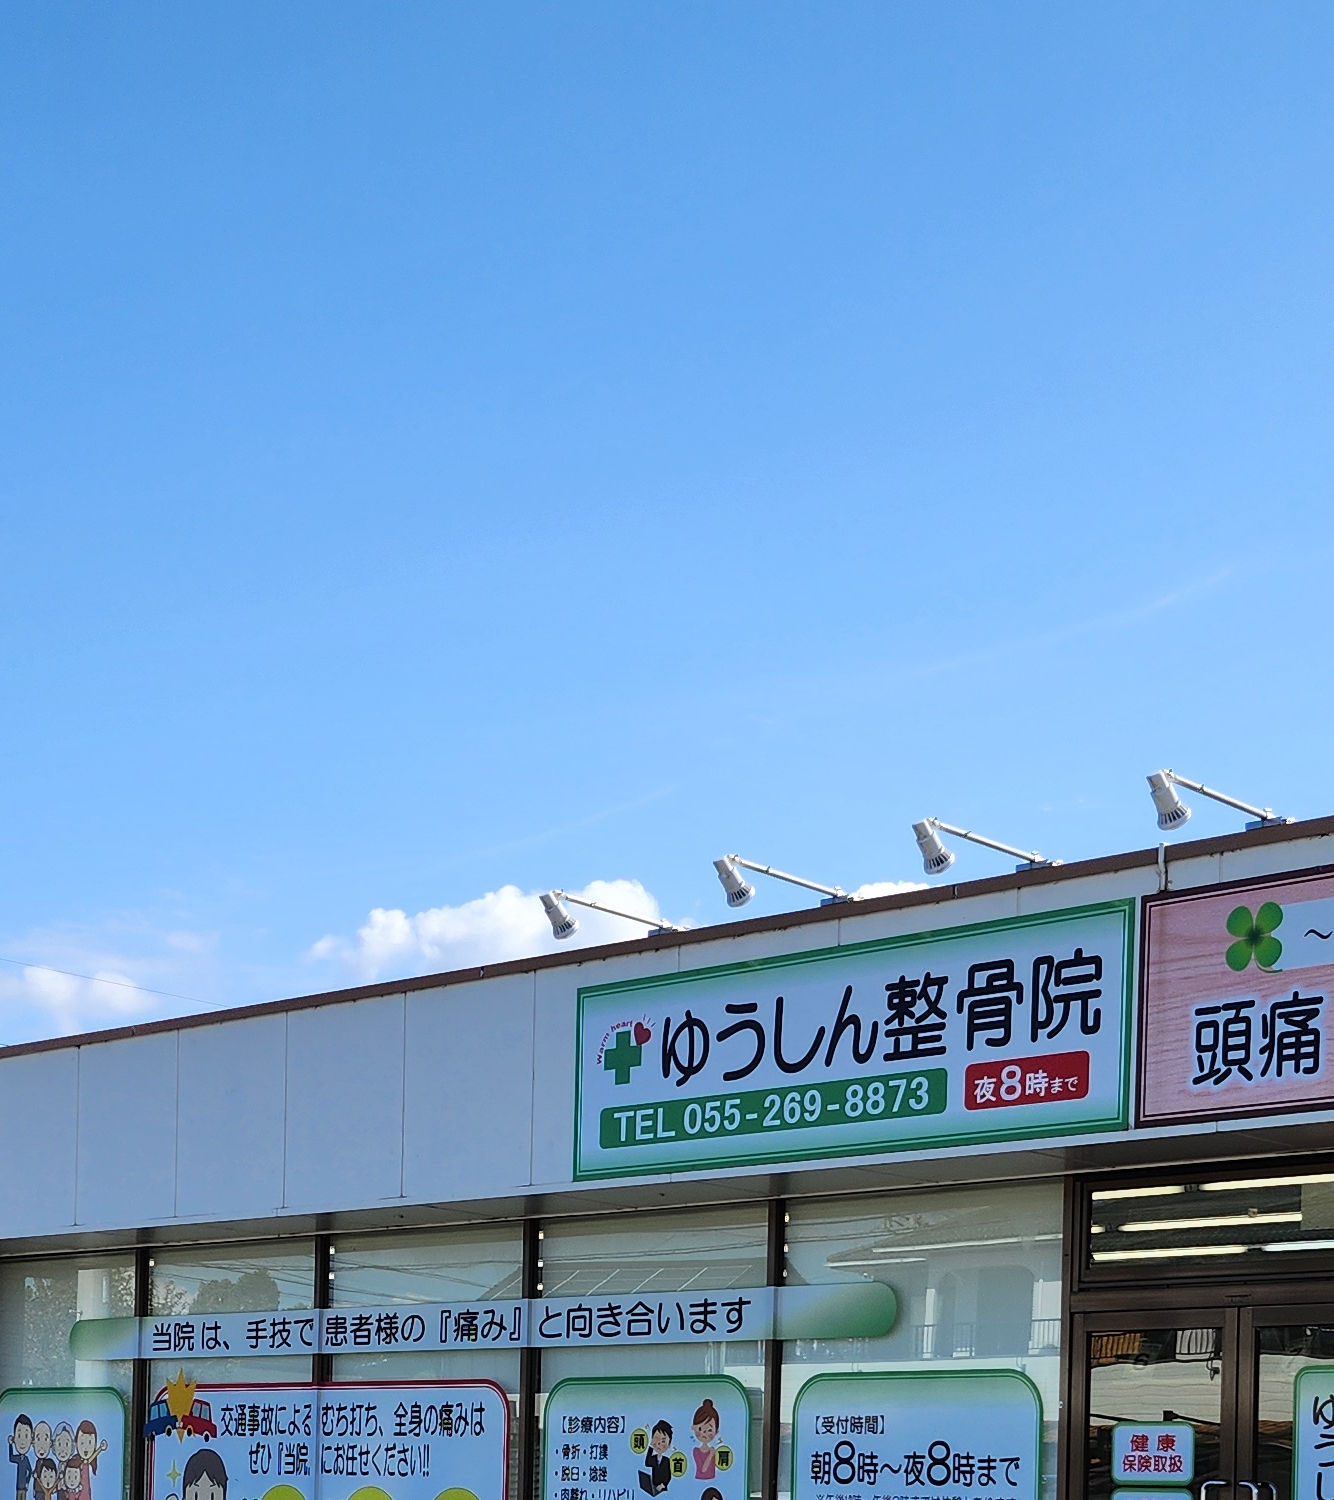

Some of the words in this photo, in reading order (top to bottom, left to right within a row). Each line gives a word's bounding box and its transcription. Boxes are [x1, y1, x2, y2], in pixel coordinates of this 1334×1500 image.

[661, 947, 1104, 1088] ゆうしん整骨院
[973, 1065, 1081, 1105] 夜8時まで
[612, 1108, 676, 1144] TEL
[683, 1076, 931, 1132] 055-269-8873
[633, 1433, 646, 1450] 頭
[672, 1457, 684, 1474] 首
[718, 1450, 730, 1467] 肩
[1122, 1454, 1184, 1474] 保険取扱
